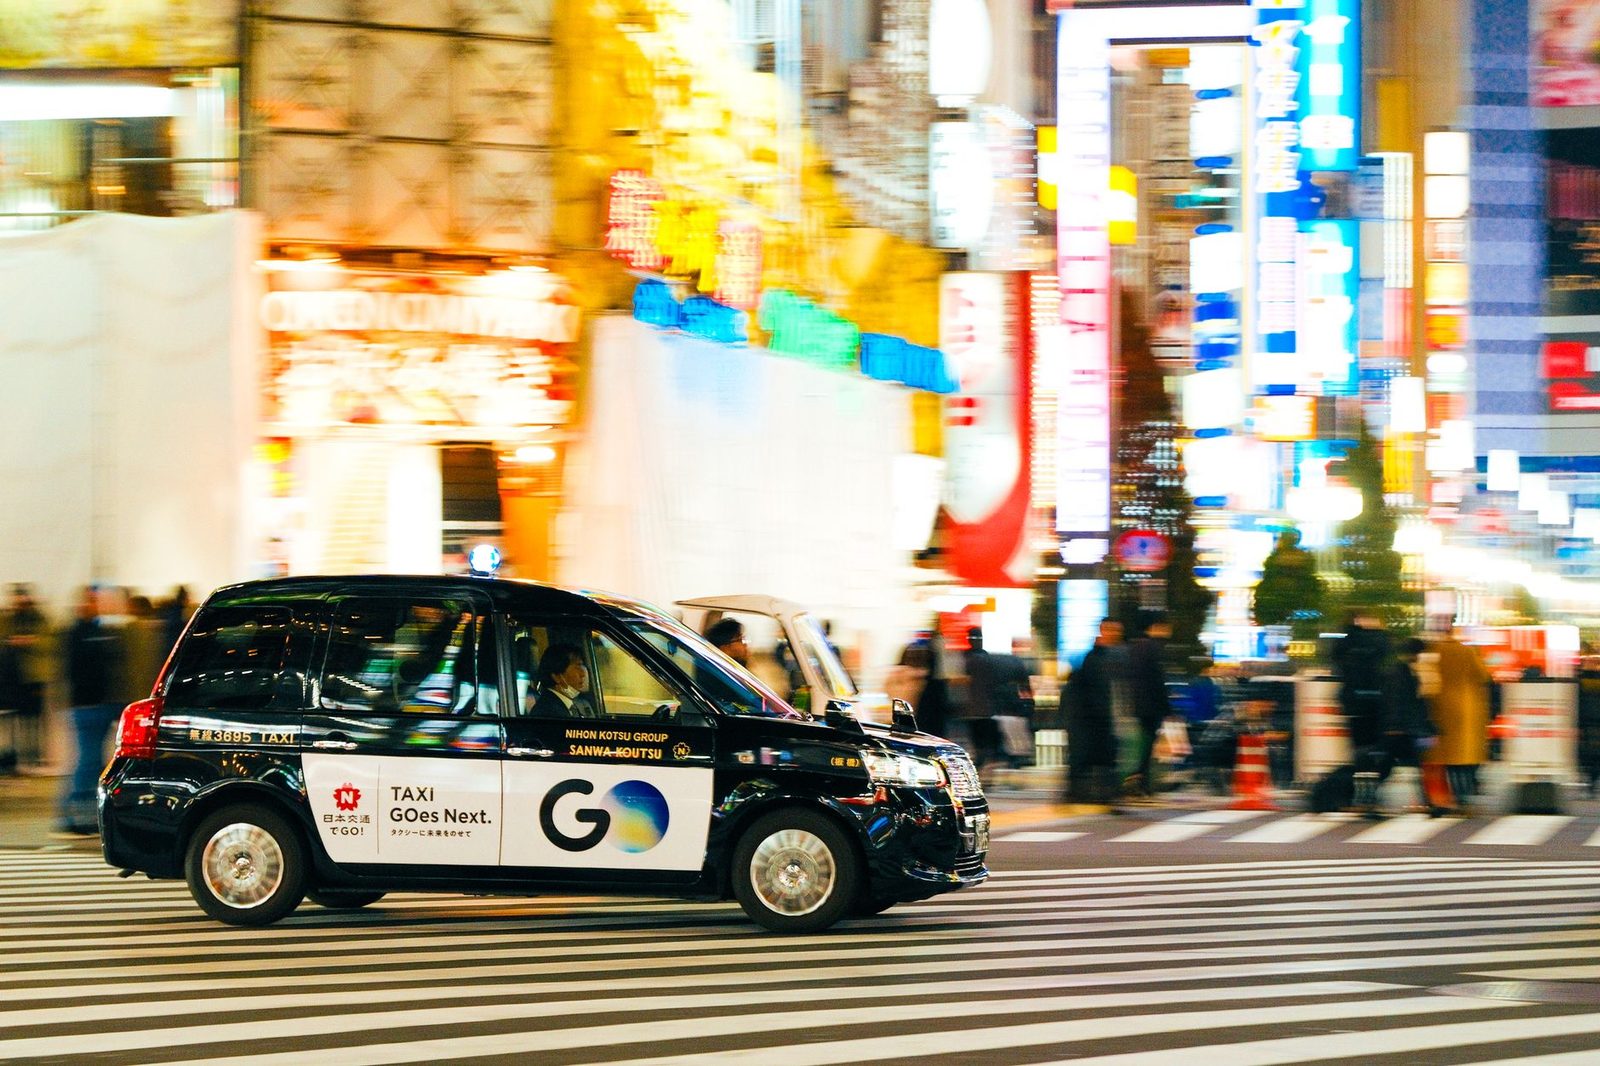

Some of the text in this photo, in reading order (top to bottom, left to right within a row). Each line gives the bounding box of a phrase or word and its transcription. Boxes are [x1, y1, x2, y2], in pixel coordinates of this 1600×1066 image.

[260, 731, 294, 744] TAXI
[565, 729, 669, 743] NIHON KOTSU GROUP
[569, 744, 662, 760] SANWA KOUTSU
[390, 786, 434, 802] TAXI
[323, 814, 371, 824] 日本交通
[390, 807, 492, 825] GOes Next.
[539, 778, 670, 853] GO
[329, 826, 364, 836] でGO!
[391, 829, 472, 838] タクシーに未来をのせて
